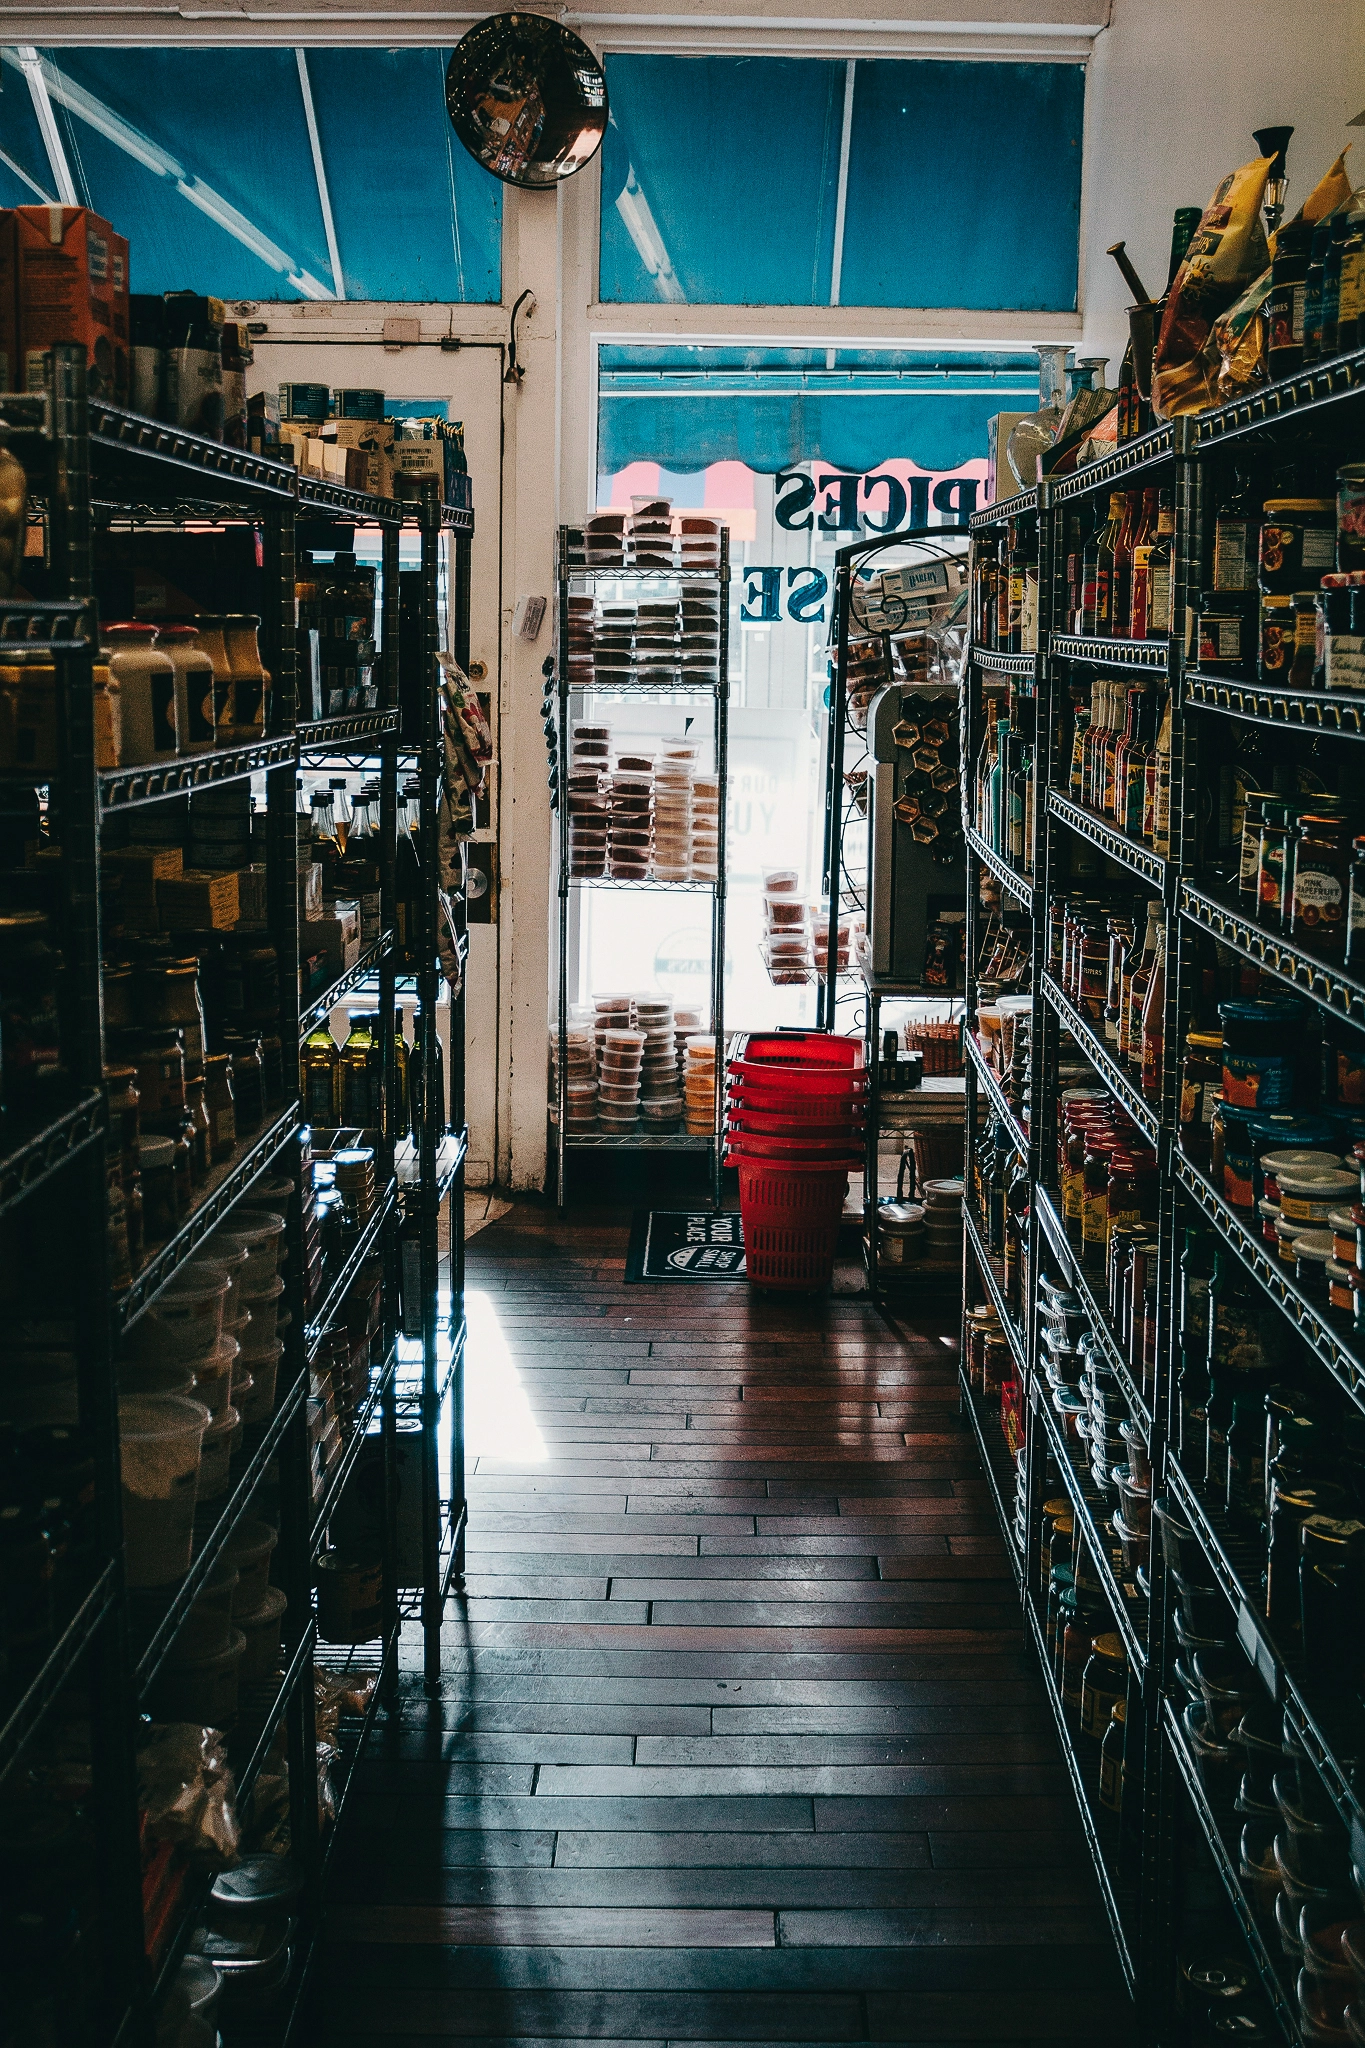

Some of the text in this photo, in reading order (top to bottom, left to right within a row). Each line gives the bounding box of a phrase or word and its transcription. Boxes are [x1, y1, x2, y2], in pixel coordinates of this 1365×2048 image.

[908, 571, 938, 588] BAKERY
[1296, 885, 1340, 896] RAPEFRUIT
[1303, 879, 1322, 888] PINK
[686, 1216, 707, 1243] PLACE
[710, 1217, 733, 1243] YOUR
[694, 1248, 721, 1269] SMALL
[714, 1250, 737, 1269] SHOP
